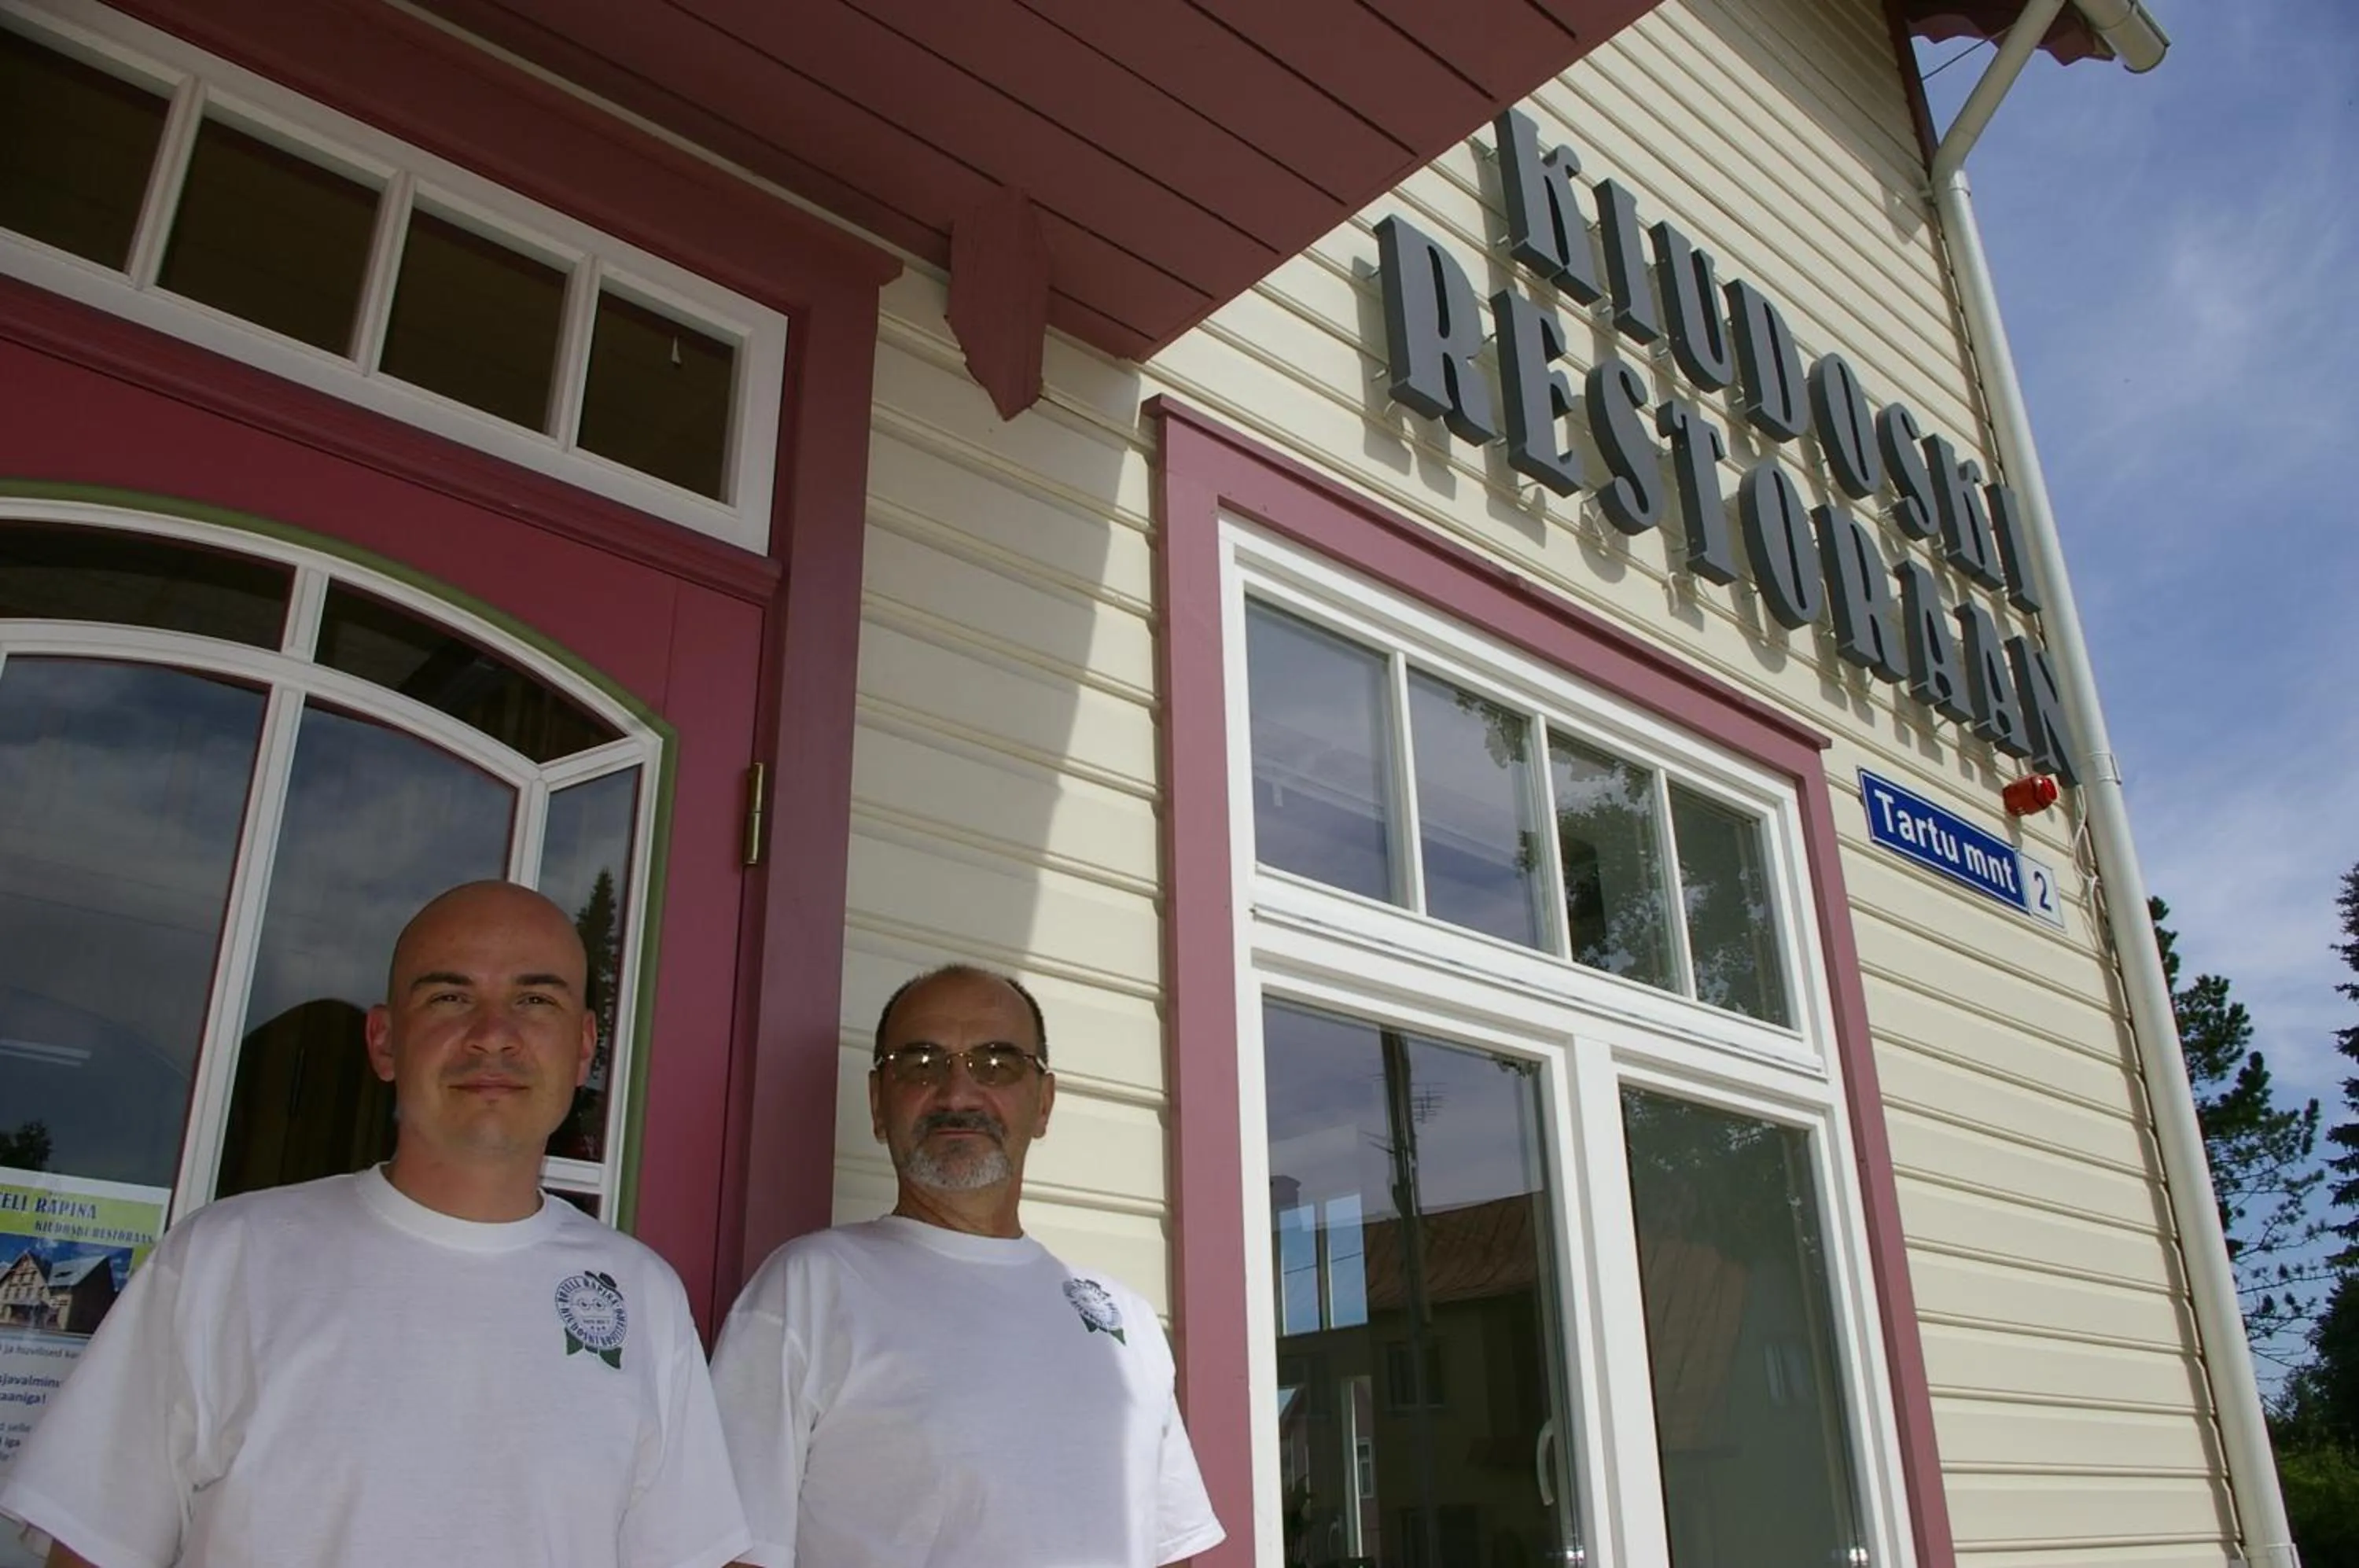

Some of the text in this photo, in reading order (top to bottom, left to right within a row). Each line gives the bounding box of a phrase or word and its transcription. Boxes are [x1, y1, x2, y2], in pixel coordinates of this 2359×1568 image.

[1372, 215, 2082, 786] RESTORAAN
[1495, 107, 2043, 615] KIUDOSKI
[1874, 788, 2017, 894] Tartu mnt
[2033, 870, 2052, 912] 2
